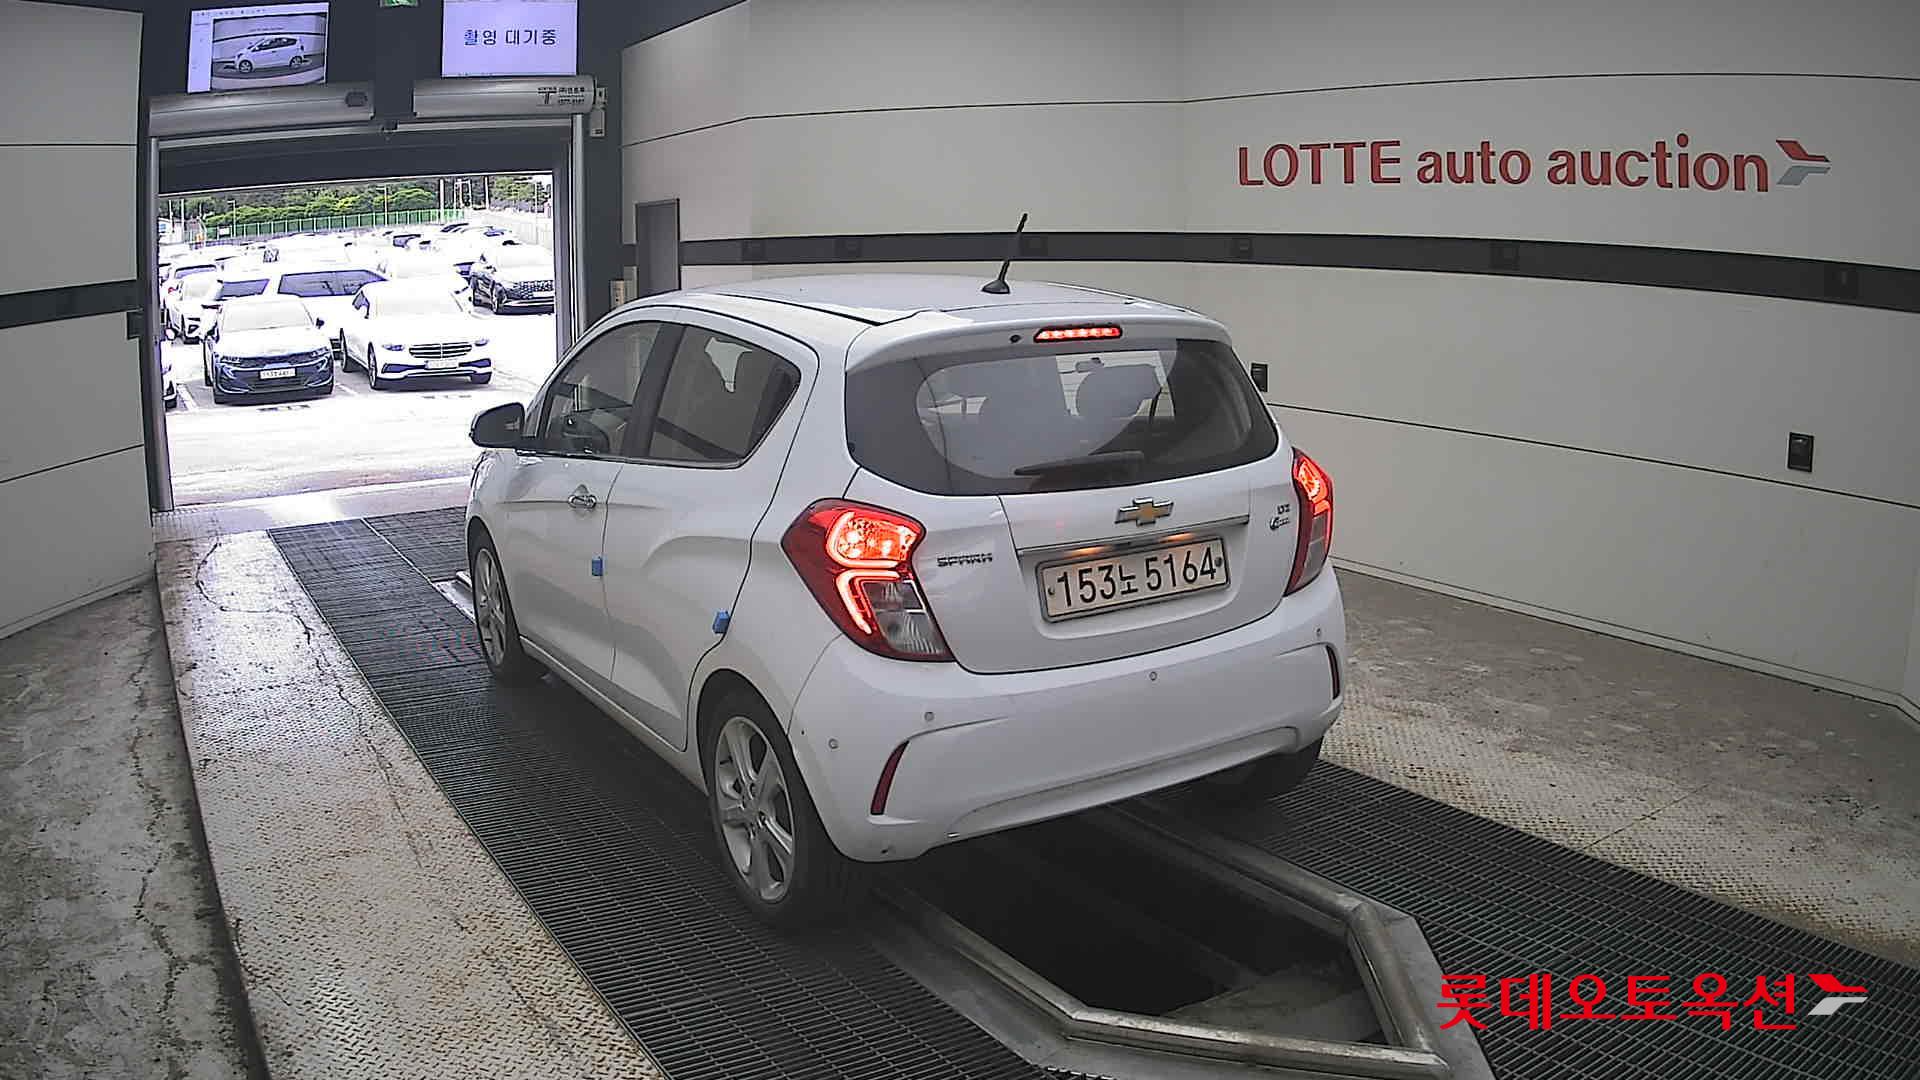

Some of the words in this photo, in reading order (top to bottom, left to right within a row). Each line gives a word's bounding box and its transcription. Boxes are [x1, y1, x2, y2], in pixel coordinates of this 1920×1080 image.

[505, 29, 557, 46] 대기중
[1238, 140, 1400, 186] LOTTE
[1417, 141, 1531, 184] auto
[1547, 133, 1768, 192] auction
[1057, 565, 1139, 607] 153노
[1144, 546, 1217, 592] 5164
